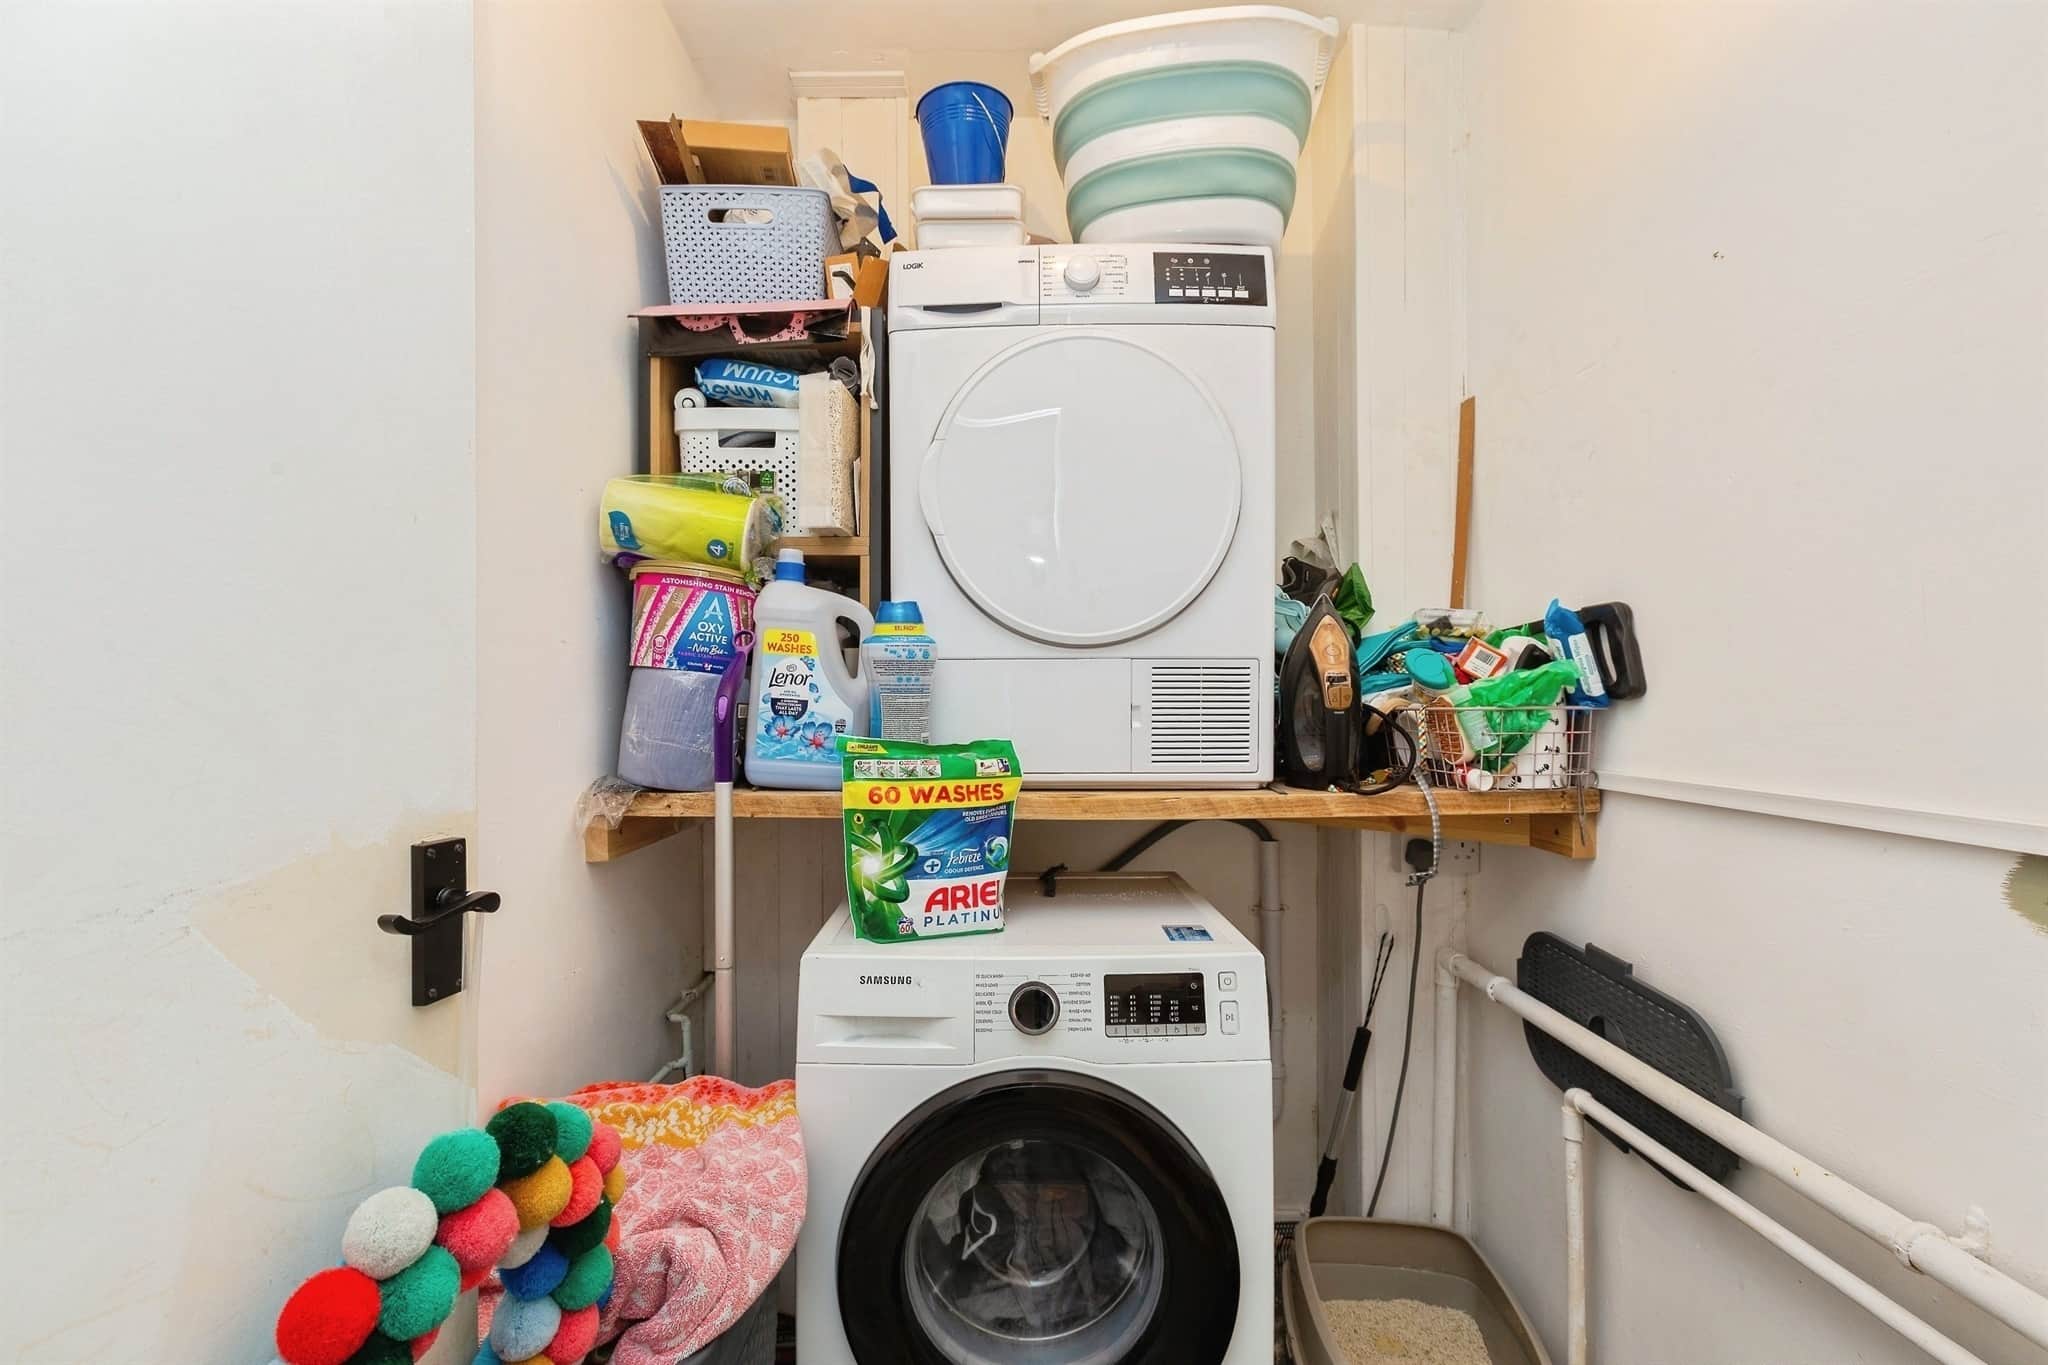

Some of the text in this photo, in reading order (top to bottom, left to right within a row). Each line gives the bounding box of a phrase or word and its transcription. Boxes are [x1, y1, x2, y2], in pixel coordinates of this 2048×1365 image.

[903, 262, 924, 270] LOGIK
[710, 544, 724, 556] 4
[661, 577, 713, 589] ASTONISHING
[714, 584, 735, 593] STAIN
[698, 622, 725, 634] OXY
[689, 632, 728, 644] ACTIVE
[780, 633, 800, 643] 250
[767, 642, 812, 654] WASHES
[769, 668, 813, 688] Lenor
[868, 783, 1004, 805] 60 WASHES
[900, 924, 910, 933] 60
[859, 976, 912, 984] SAMSUNG
